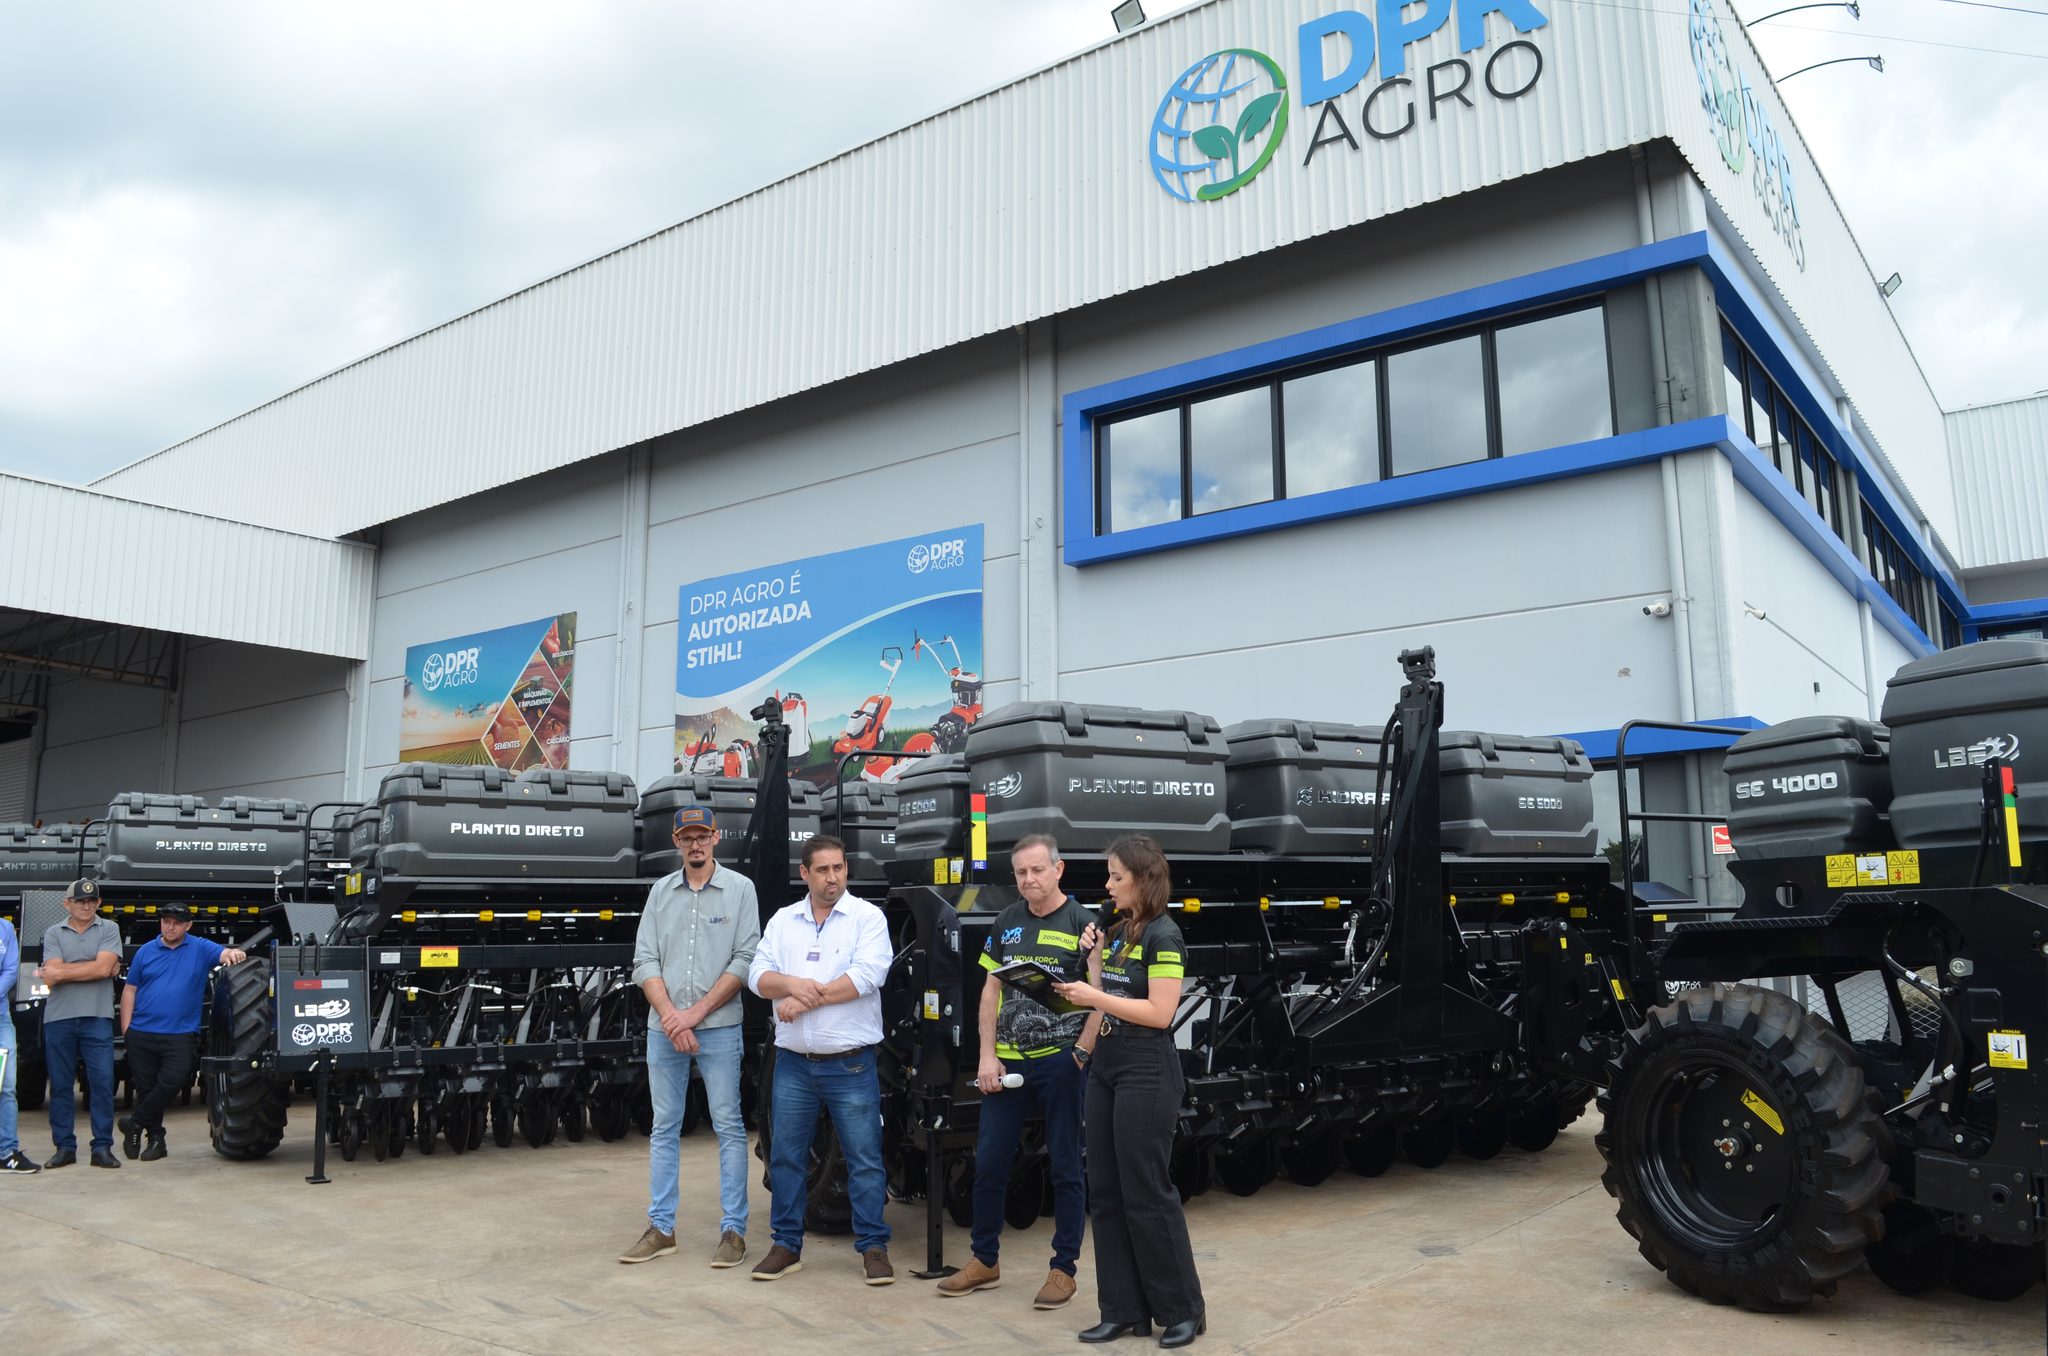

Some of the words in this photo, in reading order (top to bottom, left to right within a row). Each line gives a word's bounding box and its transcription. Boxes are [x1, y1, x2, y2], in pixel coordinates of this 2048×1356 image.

[1302, 40, 1543, 166] AGRO
[930, 539, 964, 560] DPR
[930, 555, 964, 571] AGRO
[690, 590, 726, 615] DPR
[731, 578, 784, 606] AGRO
[790, 569, 801, 594] É
[688, 600, 812, 642] AUTORIZADA
[445, 648, 478, 674] DPR
[687, 641, 743, 669] STIHL!
[443, 668, 478, 688] AGRO
[523, 688, 547, 698] MÁQUINAS
[522, 697, 551, 707] IMPLEMENTOS
[494, 740, 520, 750] SEMENTES
[1069, 777, 1147, 794] PLANTIO
[1153, 778, 1215, 797] DIRETO
[1736, 780, 1765, 799] SE
[1773, 772, 1838, 794] 4000
[912, 798, 936, 814] 5000
[1518, 797, 1535, 809] SE
[1537, 798, 1562, 810] 5000
[450, 823, 520, 836] PLANTIO
[525, 824, 584, 837] DIRETO
[789, 831, 815, 841] US
[156, 840, 213, 851] PLANTIO
[217, 841, 267, 852] DIRETO
[1042, 934, 1074, 945] ZOOMLION
[1034, 956, 1059, 965] FORÇA
[316, 1023, 352, 1037] DPR
[317, 1034, 352, 1044] AGRO
